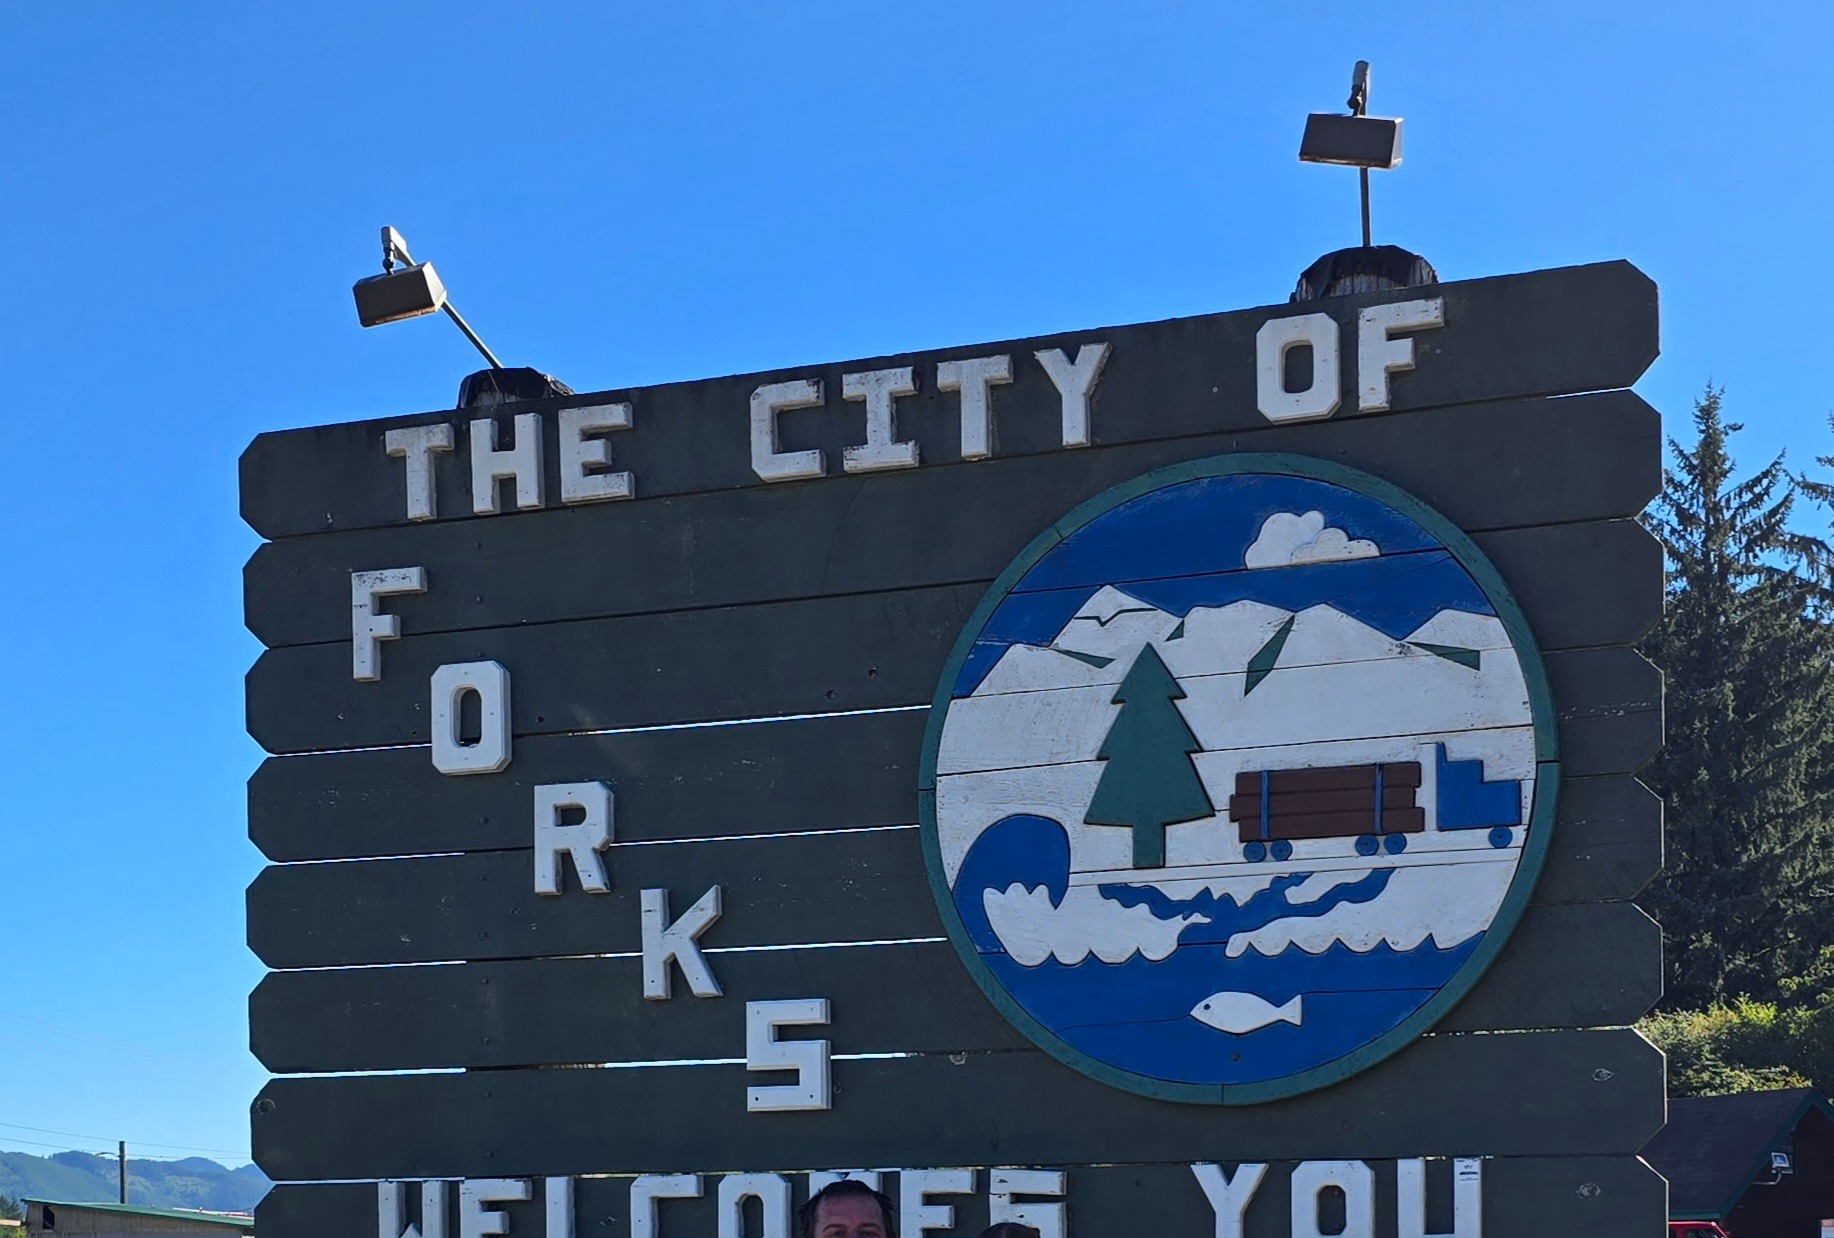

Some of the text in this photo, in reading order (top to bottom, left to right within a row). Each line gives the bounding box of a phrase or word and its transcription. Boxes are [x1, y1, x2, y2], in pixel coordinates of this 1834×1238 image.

[384, 296, 1446, 522] THE CITY OF
